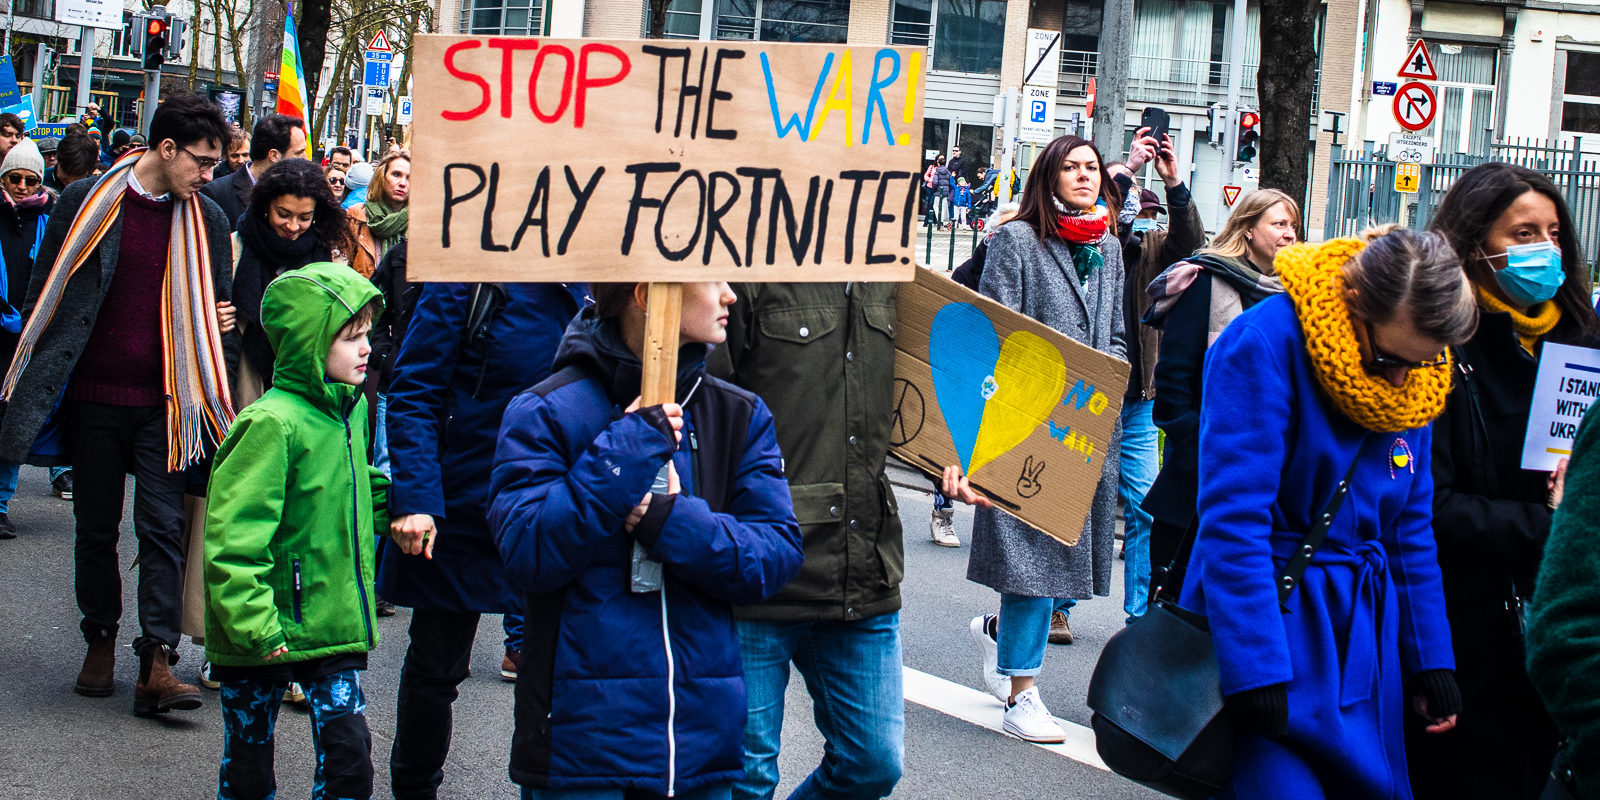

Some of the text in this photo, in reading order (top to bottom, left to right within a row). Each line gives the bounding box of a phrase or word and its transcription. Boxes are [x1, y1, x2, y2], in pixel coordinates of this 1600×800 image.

[1034, 33, 1054, 41] ZONE
[441, 40, 922, 147] STOP THE WAR!
[1030, 89, 1049, 97] ZONE
[32, 127, 67, 136] STOP PUT
[441, 162, 922, 267] PLAY FORTNITE!
[1559, 377, 1565, 393] I
[1063, 379, 1109, 416] NO
[1556, 399, 1588, 417] WITH
[1049, 420, 1094, 464] WAR!
